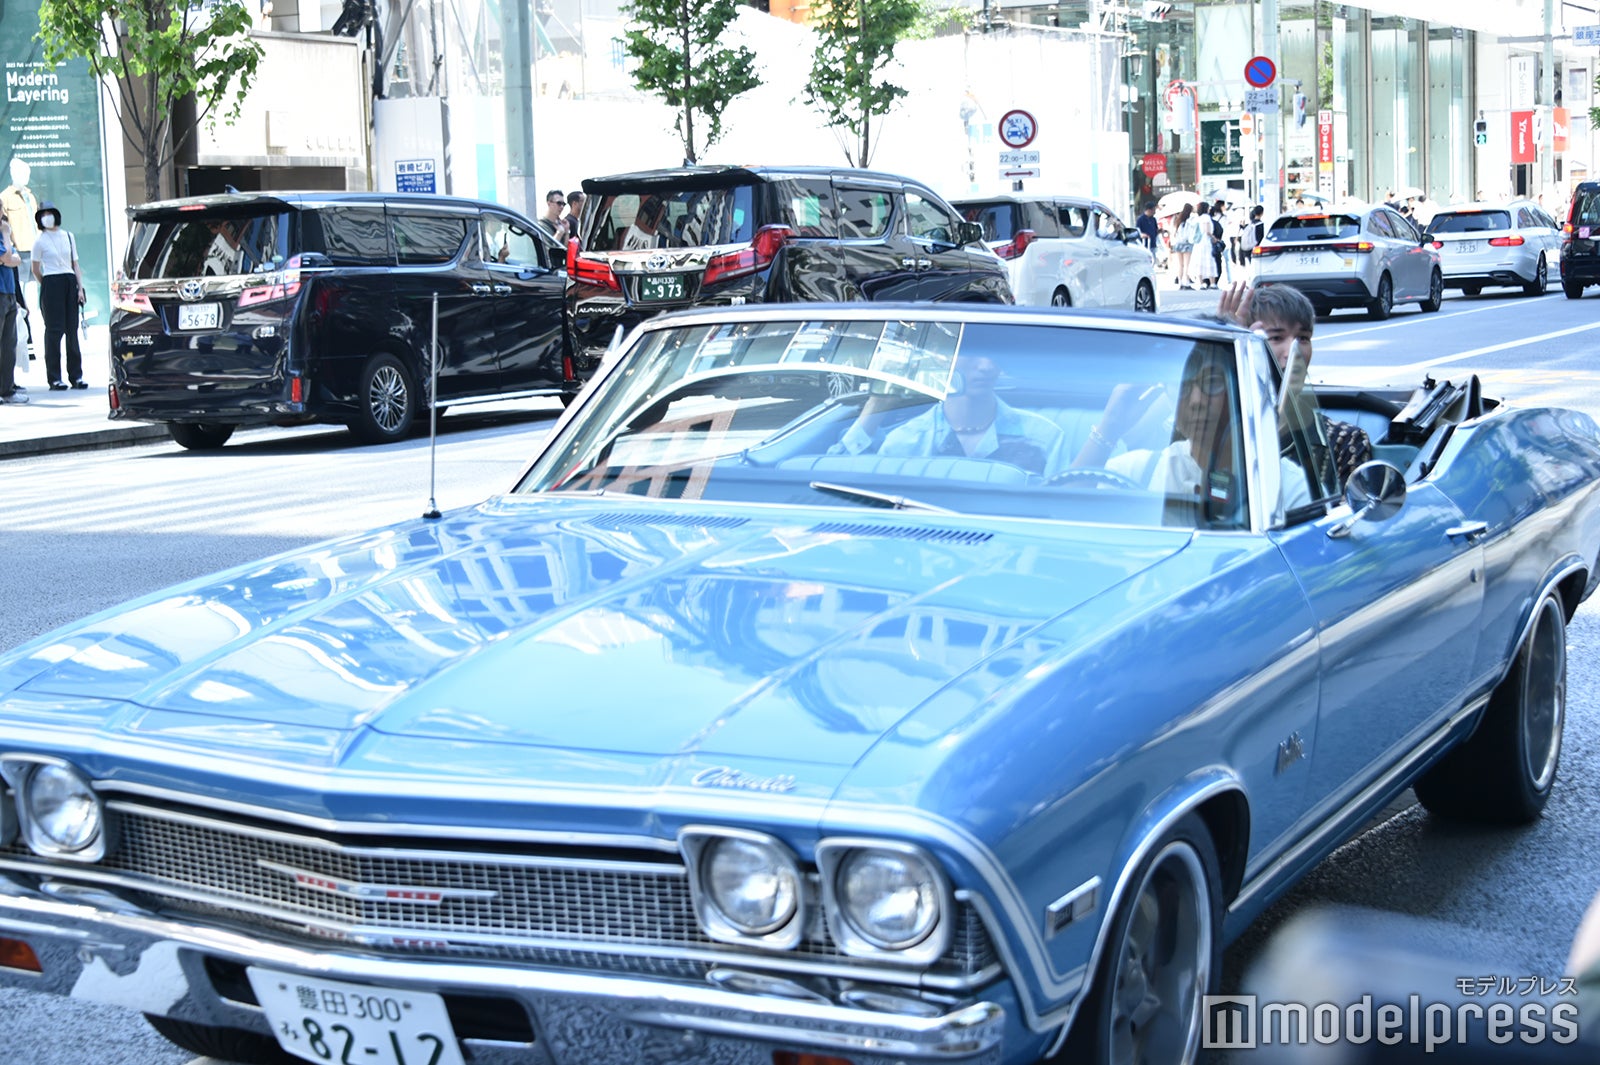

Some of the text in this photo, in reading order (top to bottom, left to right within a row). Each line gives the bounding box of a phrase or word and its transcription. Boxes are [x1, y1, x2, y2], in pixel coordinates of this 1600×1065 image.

[6, 71, 58, 87] Modern
[7, 86, 69, 105] Layering
[187, 314, 216, 327] 56-78
[296, 985, 401, 1022] 豊田300
